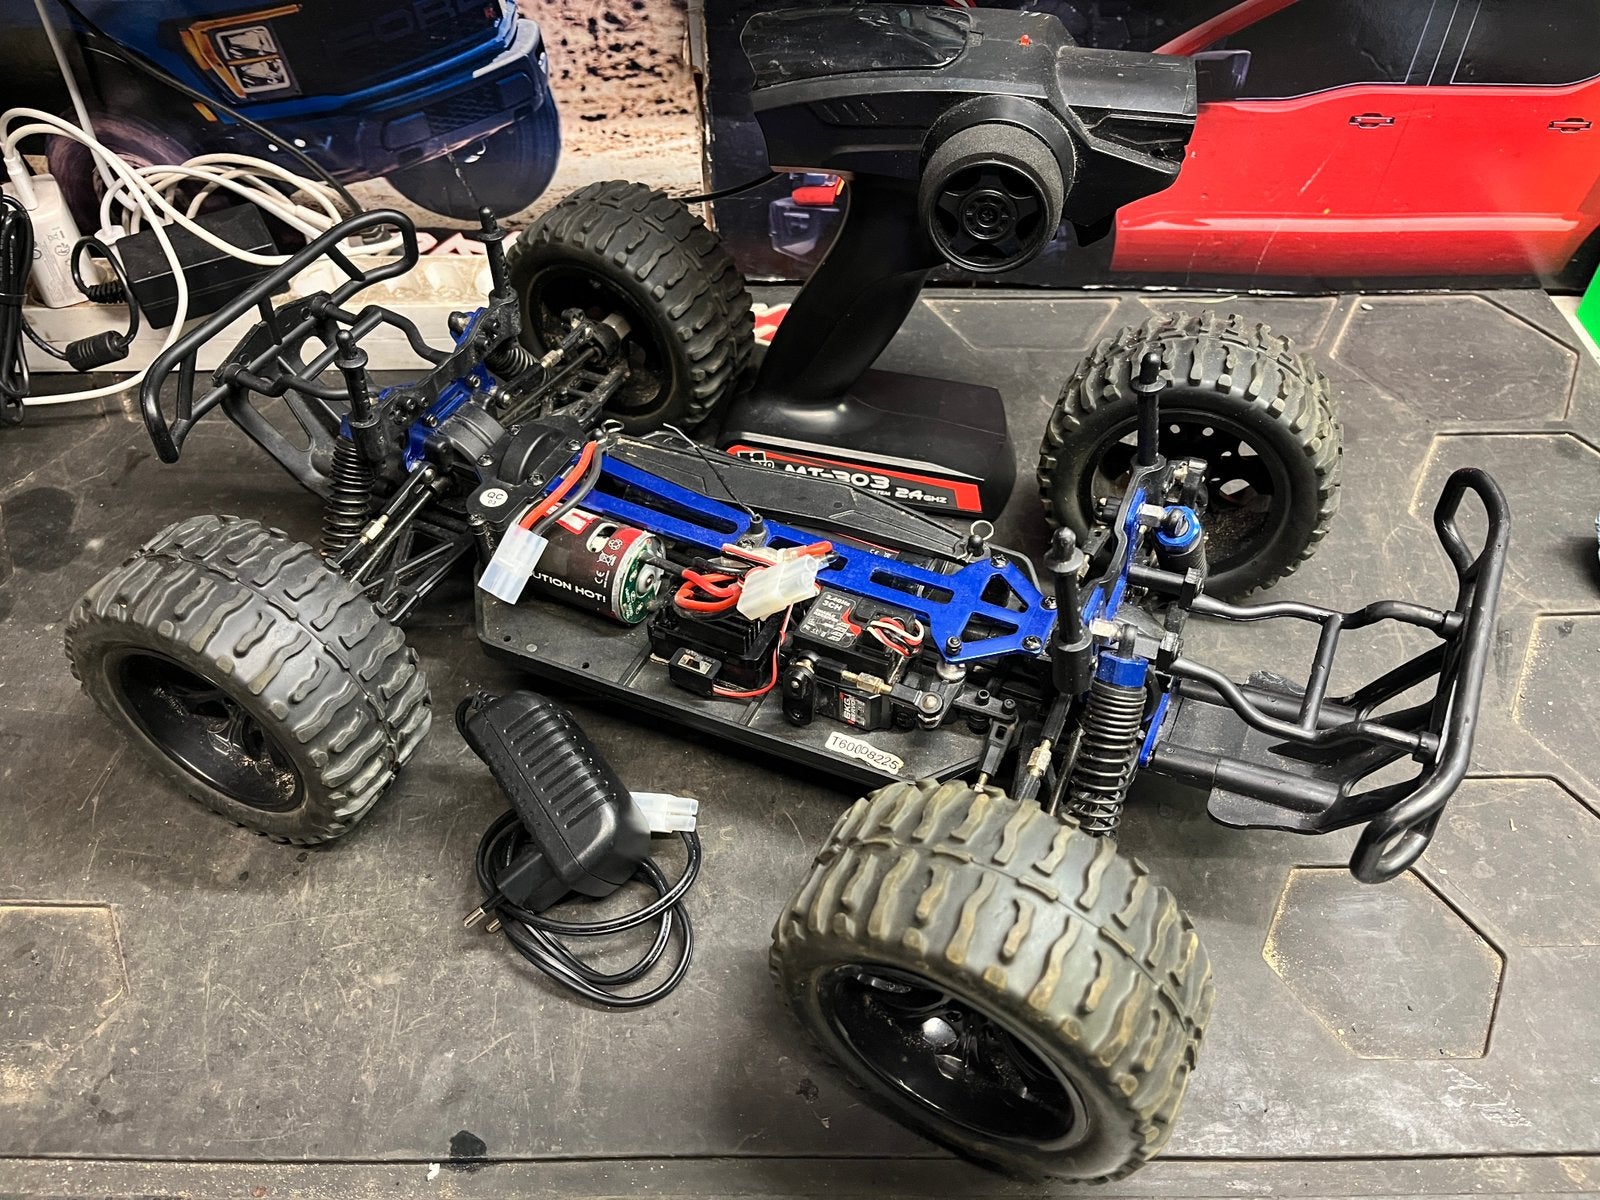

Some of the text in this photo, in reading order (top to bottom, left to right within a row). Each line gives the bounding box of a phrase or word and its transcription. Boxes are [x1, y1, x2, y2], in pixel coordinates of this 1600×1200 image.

[784, 463, 890, 490] MT-303
[487, 491, 504, 500] QC
[574, 584, 607, 603] HOT!
[822, 600, 843, 611] 3CH
